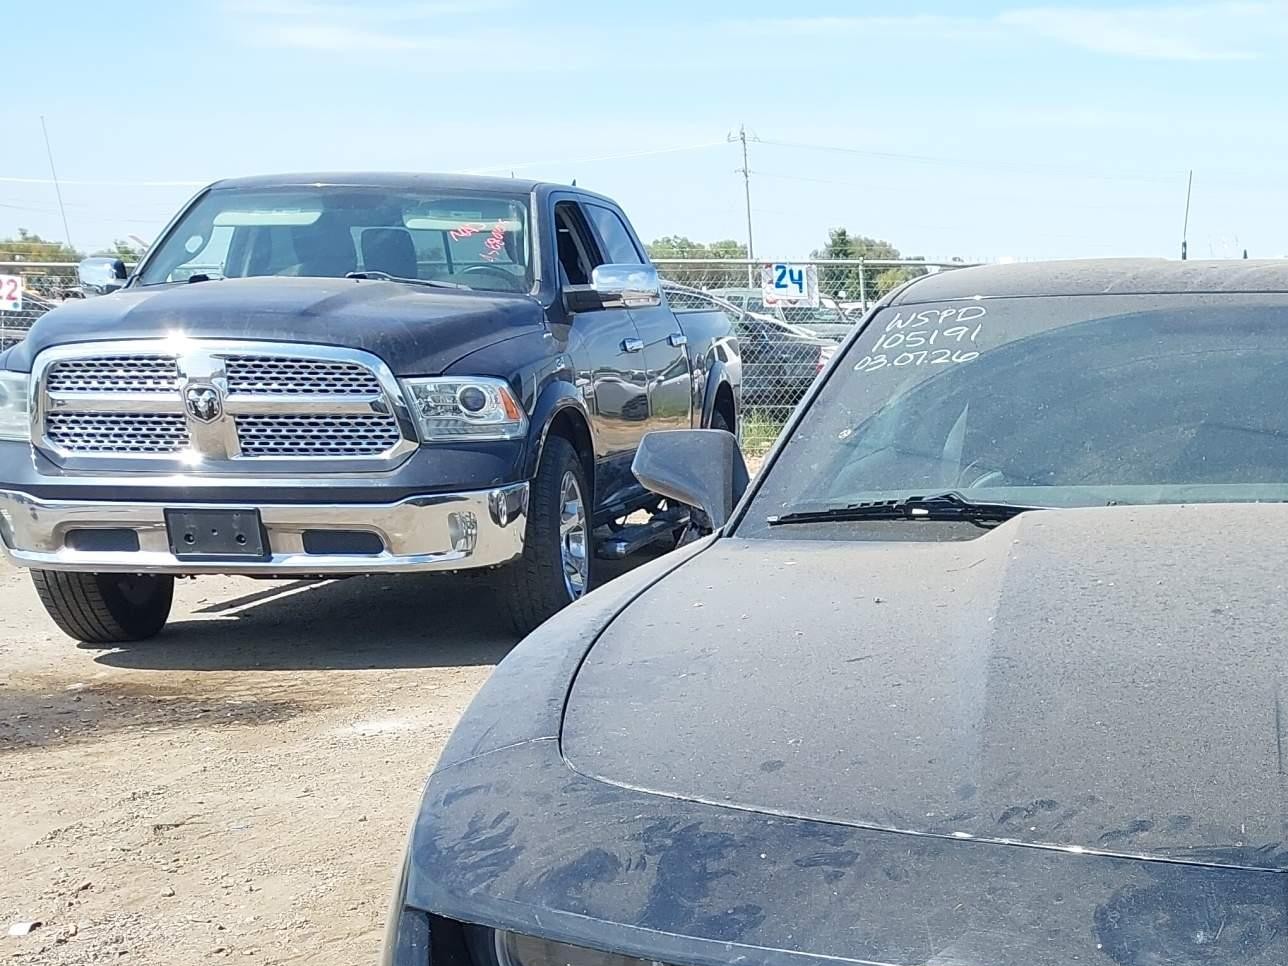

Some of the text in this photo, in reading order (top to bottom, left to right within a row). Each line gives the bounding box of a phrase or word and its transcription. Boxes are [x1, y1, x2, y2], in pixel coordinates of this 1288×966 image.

[775, 264, 803, 294] 24
[885, 306, 986, 332] WSPD
[872, 324, 982, 353] 105191
[853, 349, 980, 372] 03.07.26
